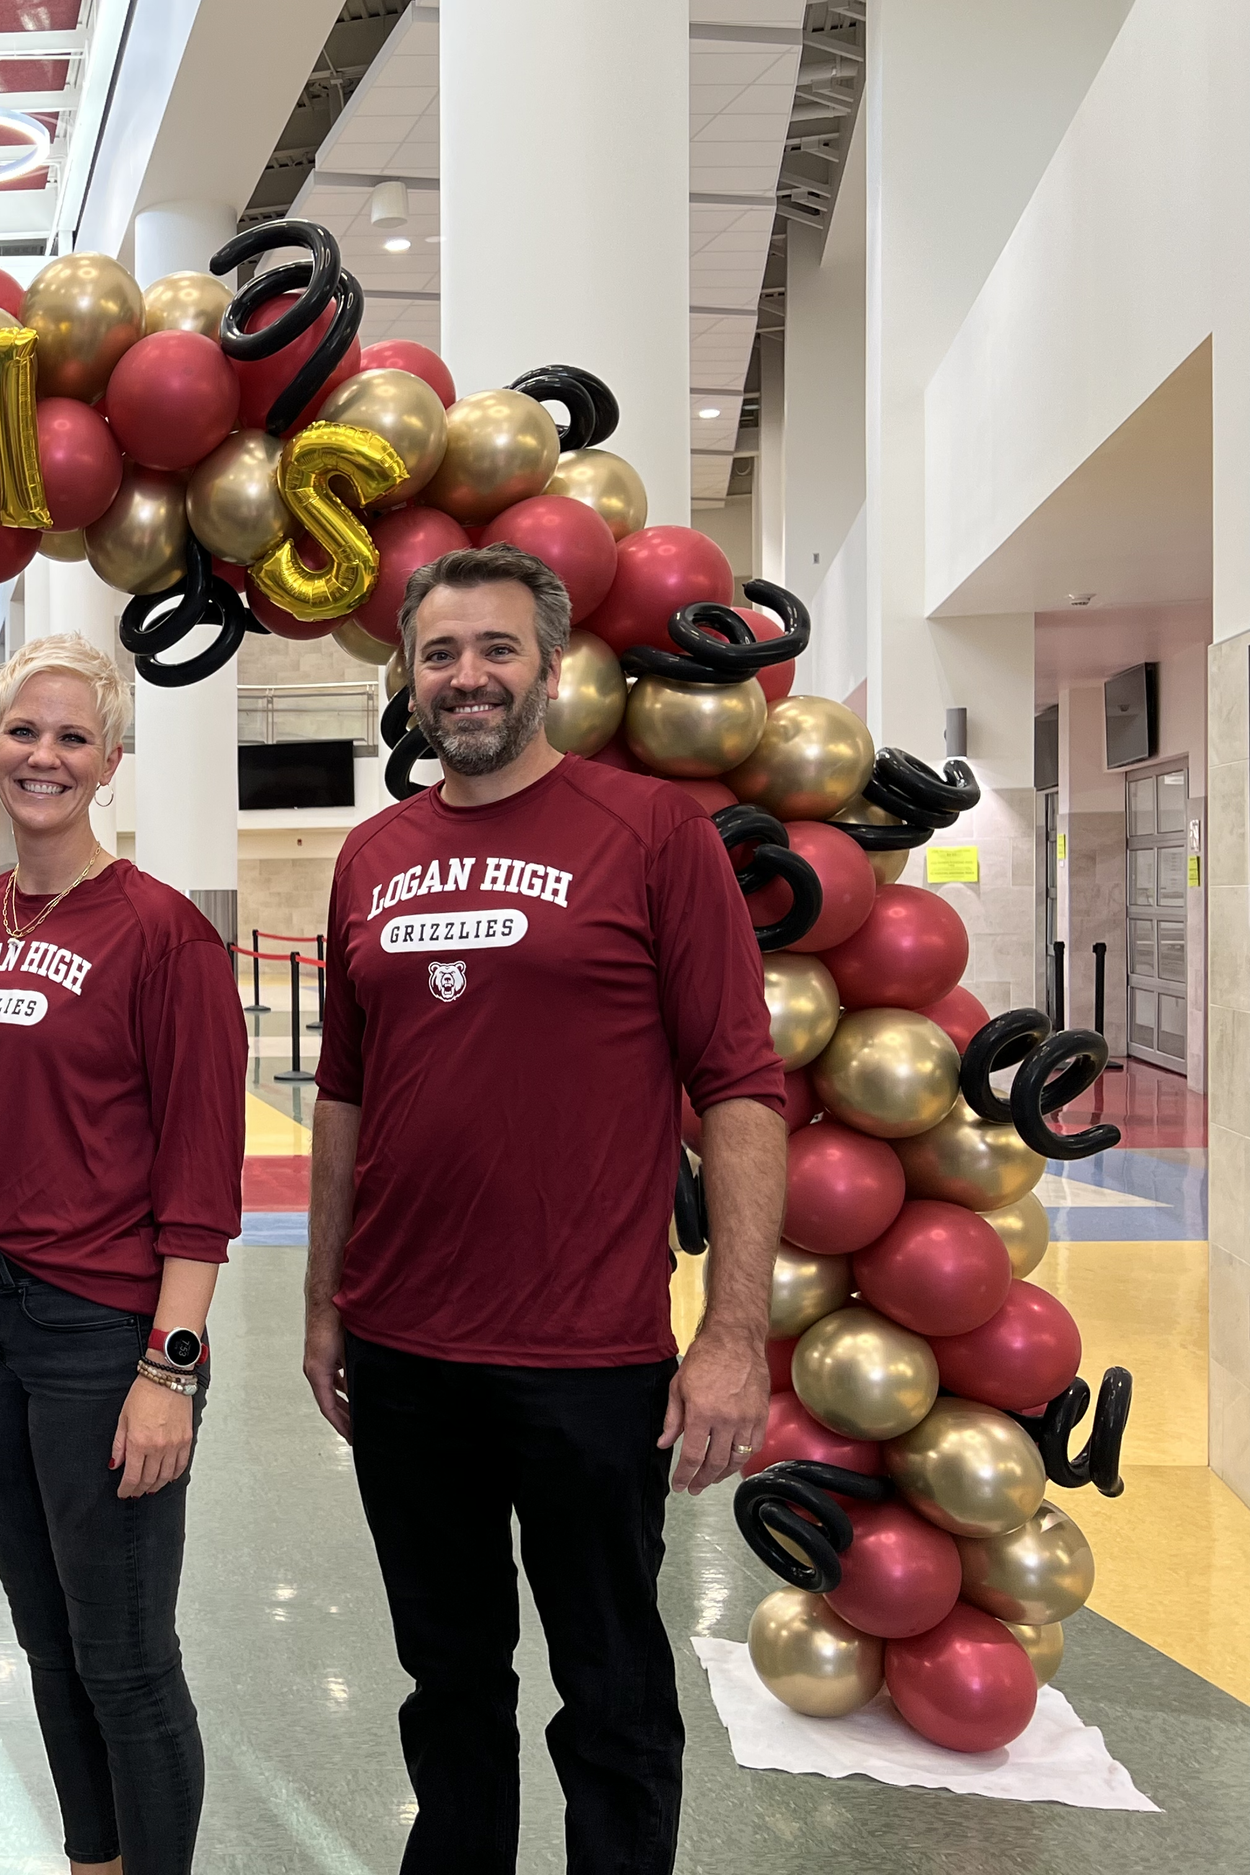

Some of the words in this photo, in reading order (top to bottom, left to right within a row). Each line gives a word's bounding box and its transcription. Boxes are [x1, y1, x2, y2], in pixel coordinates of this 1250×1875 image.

[247, 420, 411, 622] S
[366, 857, 476, 921] LOGAN
[479, 857, 573, 908] HIGH
[390, 918, 514, 944] GRIZZLIES
[19, 940, 92, 996] HIGH
